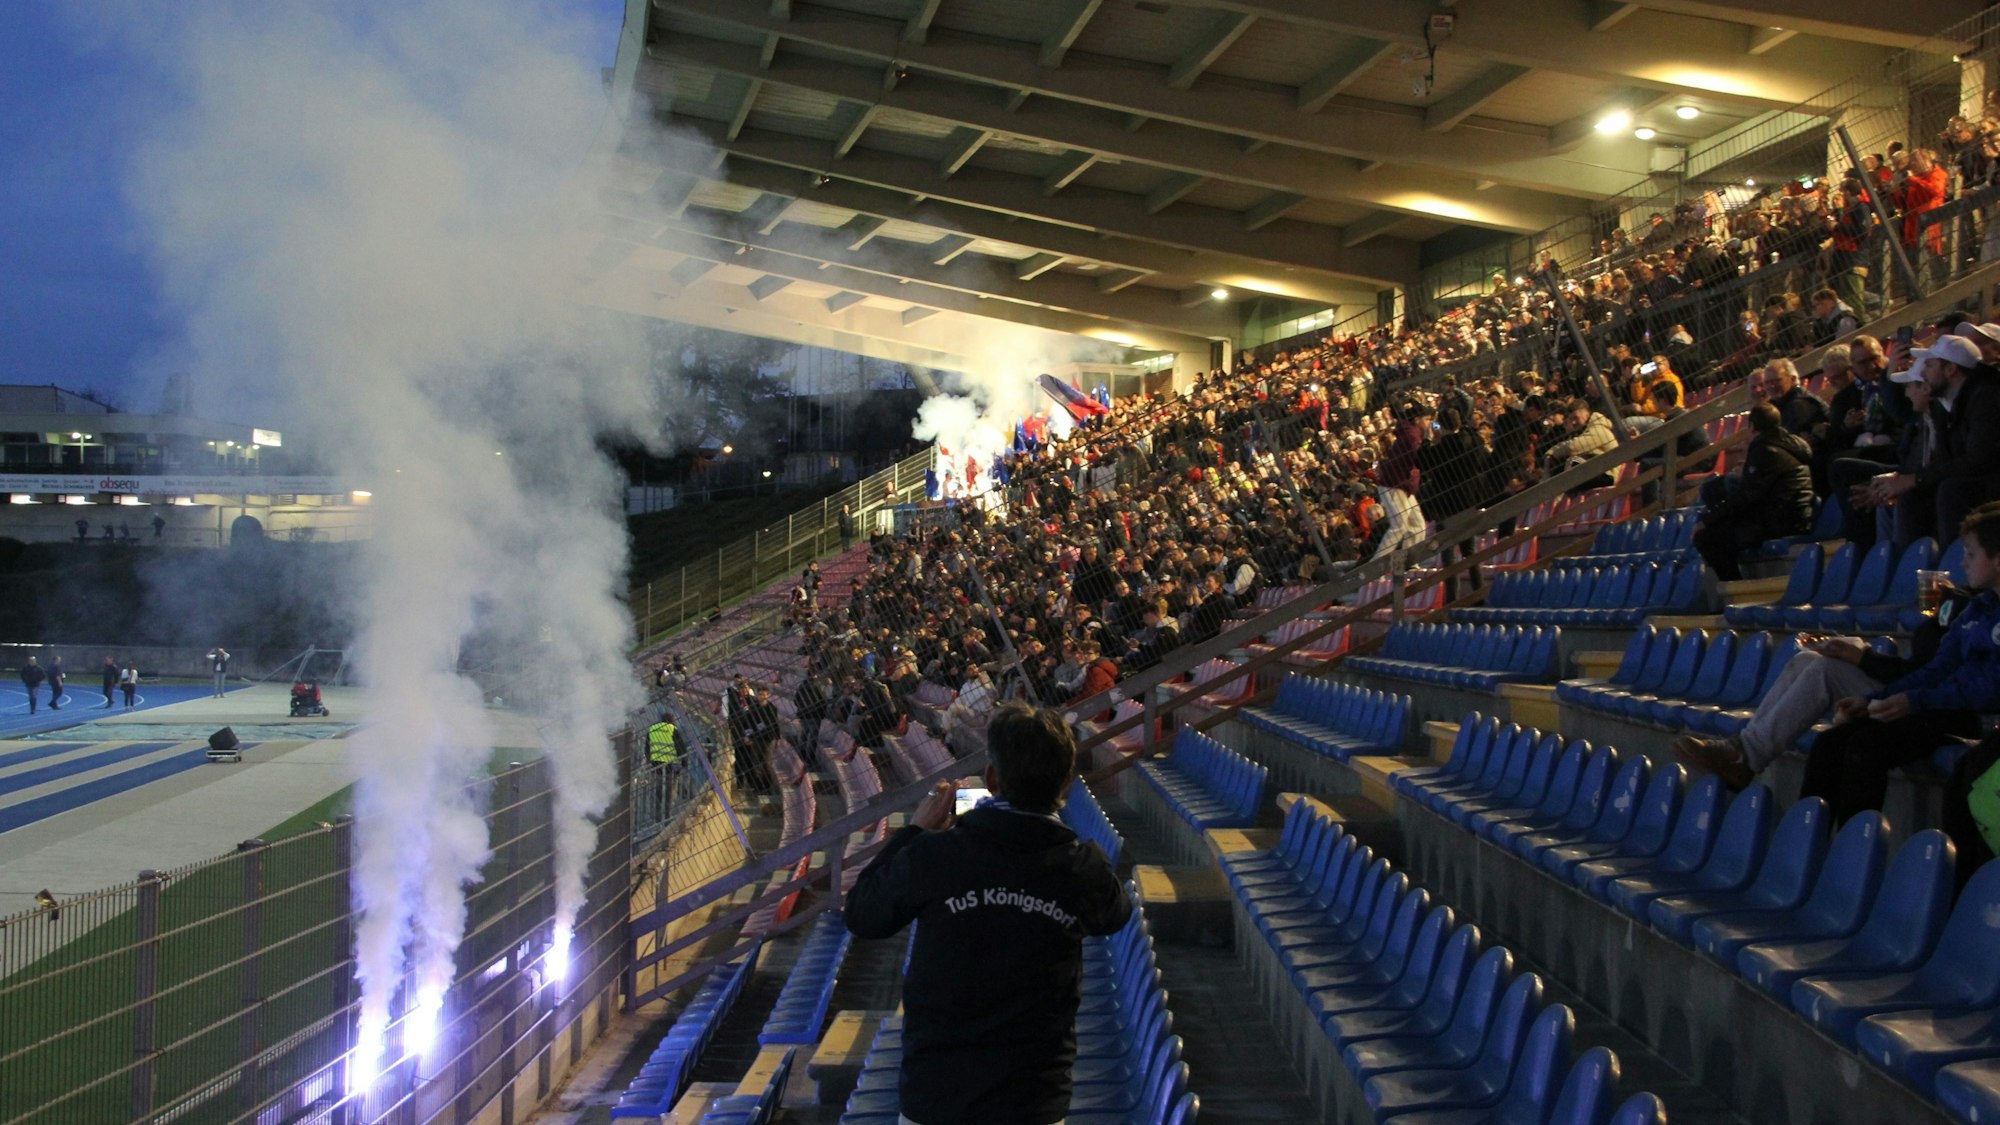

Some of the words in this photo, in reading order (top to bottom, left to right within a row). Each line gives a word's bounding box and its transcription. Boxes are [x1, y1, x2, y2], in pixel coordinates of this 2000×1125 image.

[100, 477, 139, 493] obsequ
[945, 890, 979, 914] TuS
[983, 887, 1077, 928] Königsdorf
